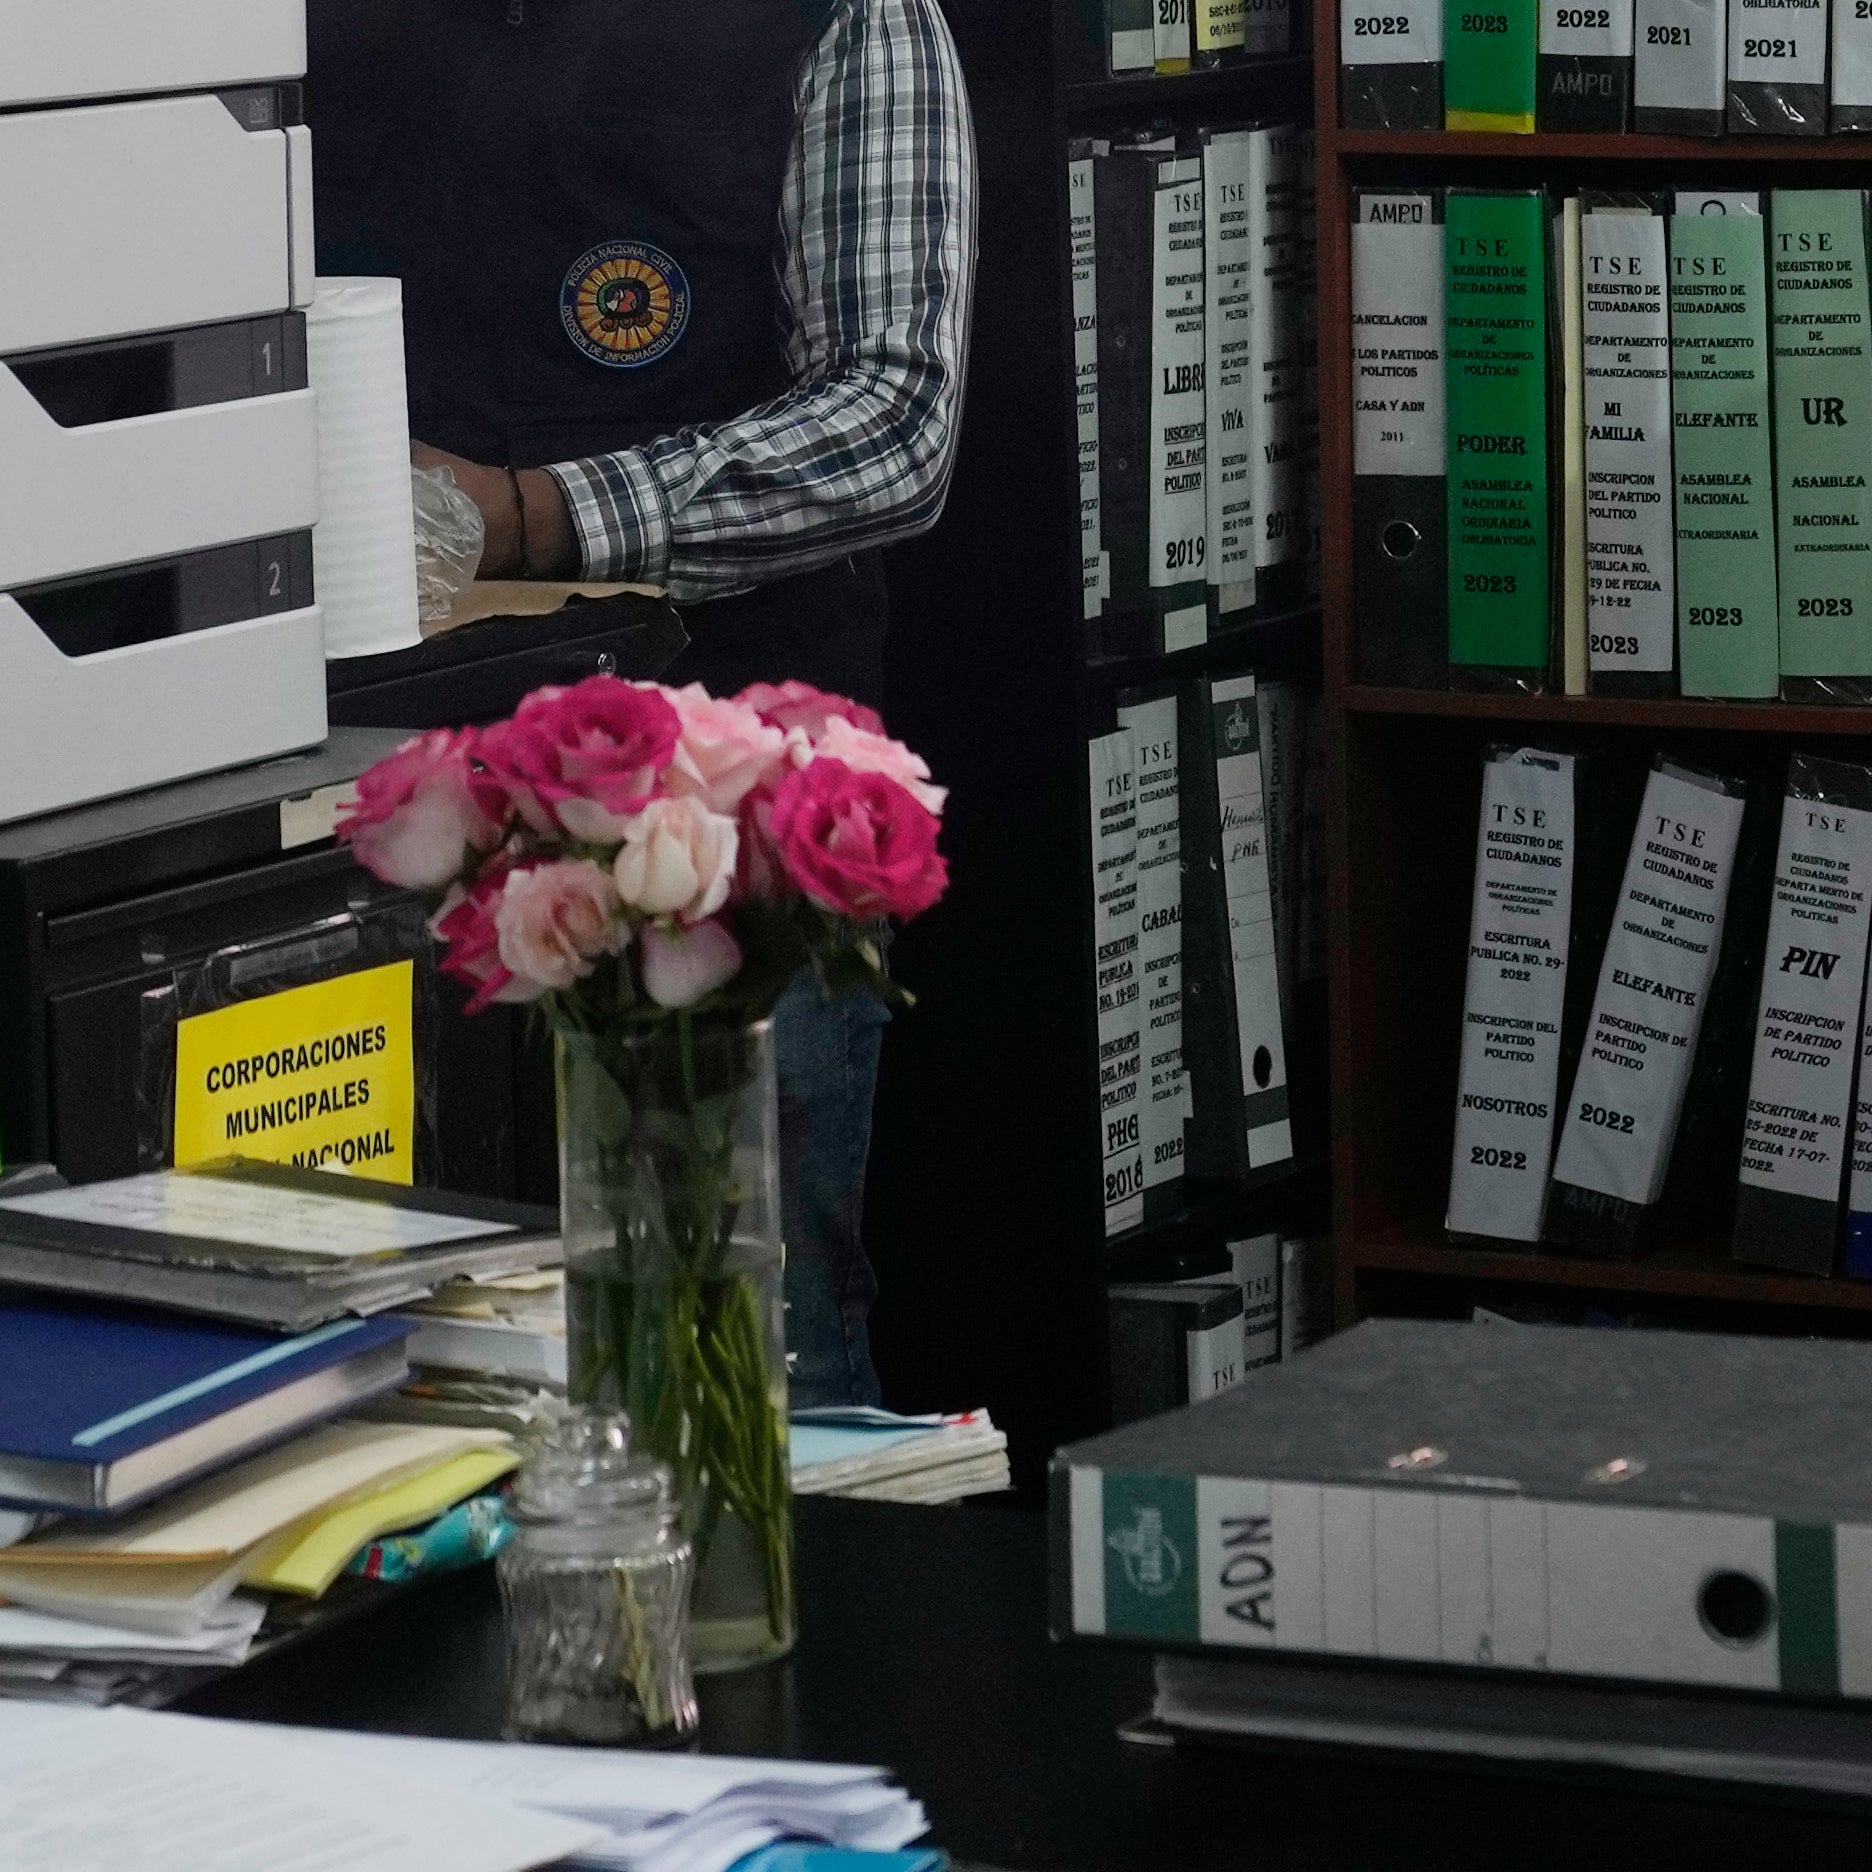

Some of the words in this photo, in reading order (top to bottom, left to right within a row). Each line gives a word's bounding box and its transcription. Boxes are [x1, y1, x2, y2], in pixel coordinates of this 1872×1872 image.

[1353, 17, 1410, 36] 2022
[1647, 27, 1692, 46] 2021
[1369, 203, 1423, 224] AMPO
[261, 342, 272, 376] 1
[1356, 400, 1387, 412] CASA
[1390, 400, 1398, 412] Y
[1401, 400, 1425, 412] ADN
[1800, 397, 1848, 426] UR
[1674, 412, 1759, 428] ELEFANTE
[1380, 430, 1405, 443] 2011
[1456, 434, 1527, 456] PODER
[268, 561, 281, 596] 2
[1688, 607, 1743, 627] 2023
[1778, 946, 1840, 980] PIN
[1611, 969, 1696, 1007] ELEFANTE
[206, 1026, 386, 1093] CORPORACIONES
[1770, 1046, 1831, 1068] POLITICO
[226, 1080, 369, 1139] MUNICIPALES
[1461, 1093, 1548, 1119] NOSOTROS
[1579, 1103, 1636, 1135] 2022
[1220, 1515, 1276, 1631] ADN
